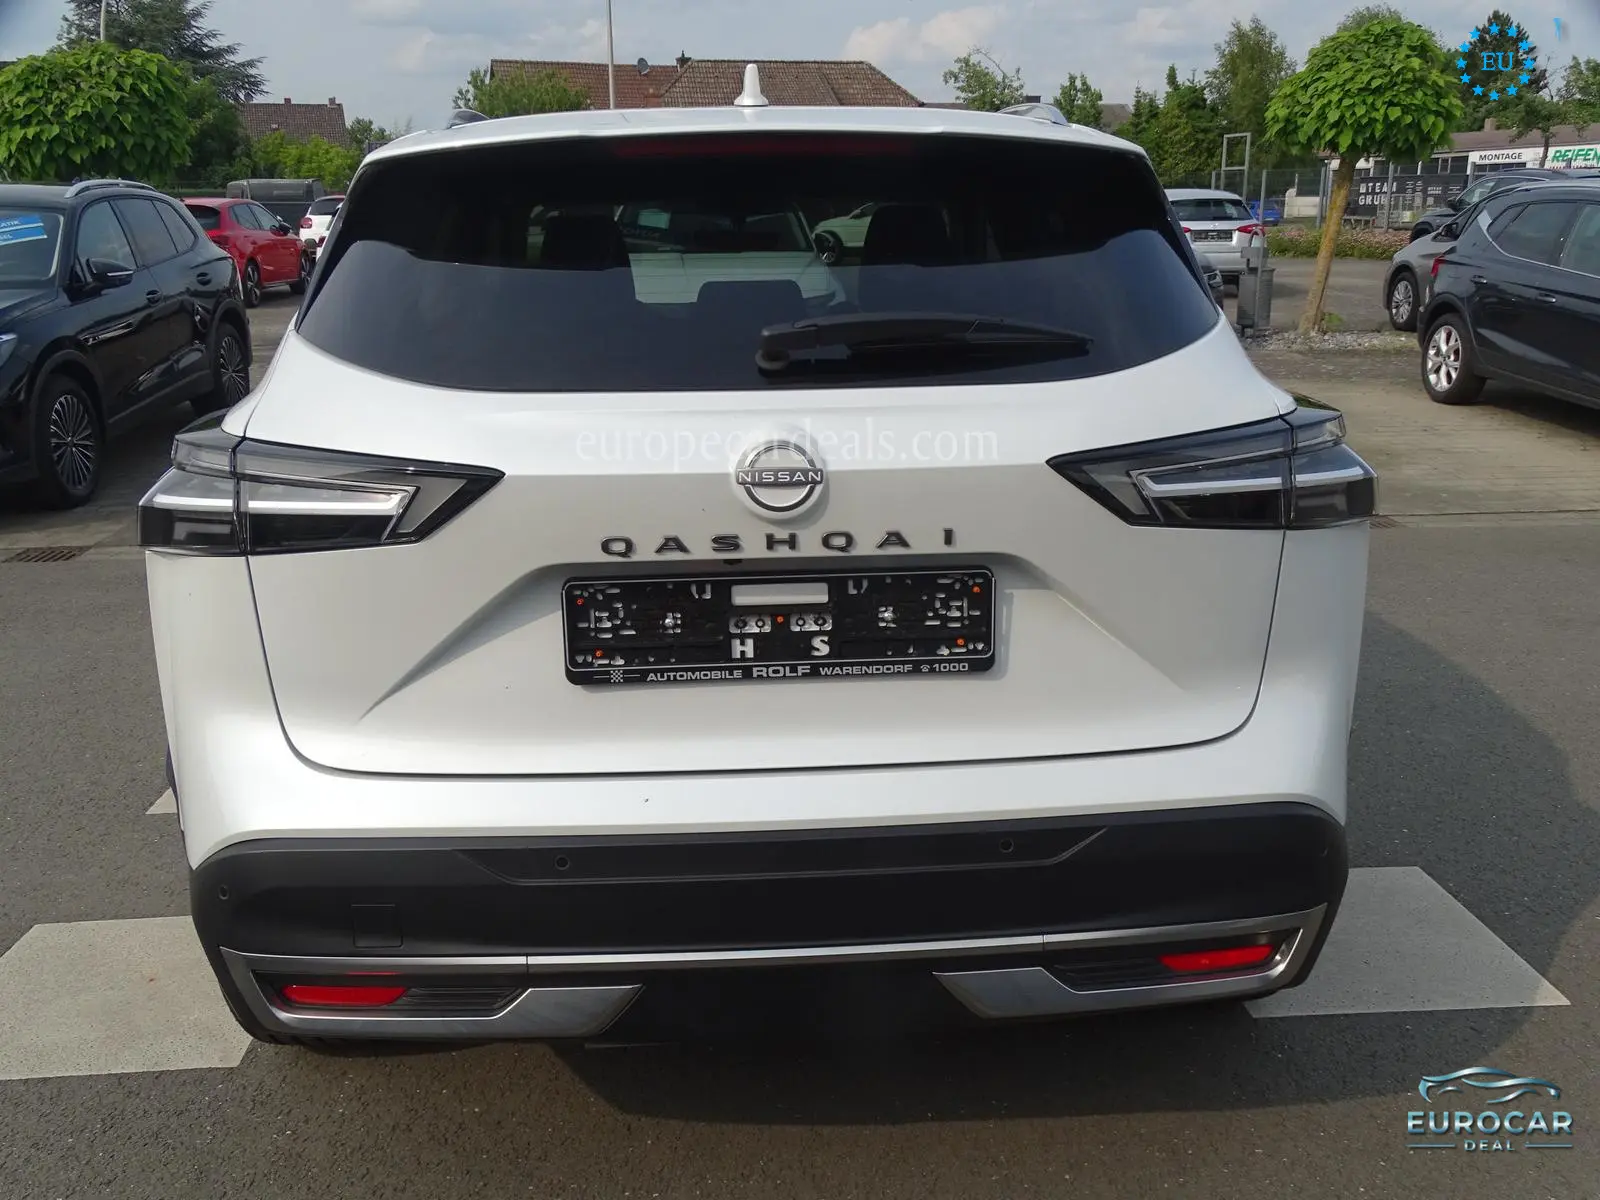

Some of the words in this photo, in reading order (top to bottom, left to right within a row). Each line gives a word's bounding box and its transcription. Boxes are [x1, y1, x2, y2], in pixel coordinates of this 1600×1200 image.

[1478, 152, 1523, 162] MONTAGE
[737, 469, 823, 484] NISSAN
[600, 527, 956, 558] QASHQAI
[646, 669, 743, 682] AUTOMOBILE
[752, 665, 811, 678] ROLF
[819, 664, 913, 676] WARENDORF
[932, 662, 969, 672] 1000
